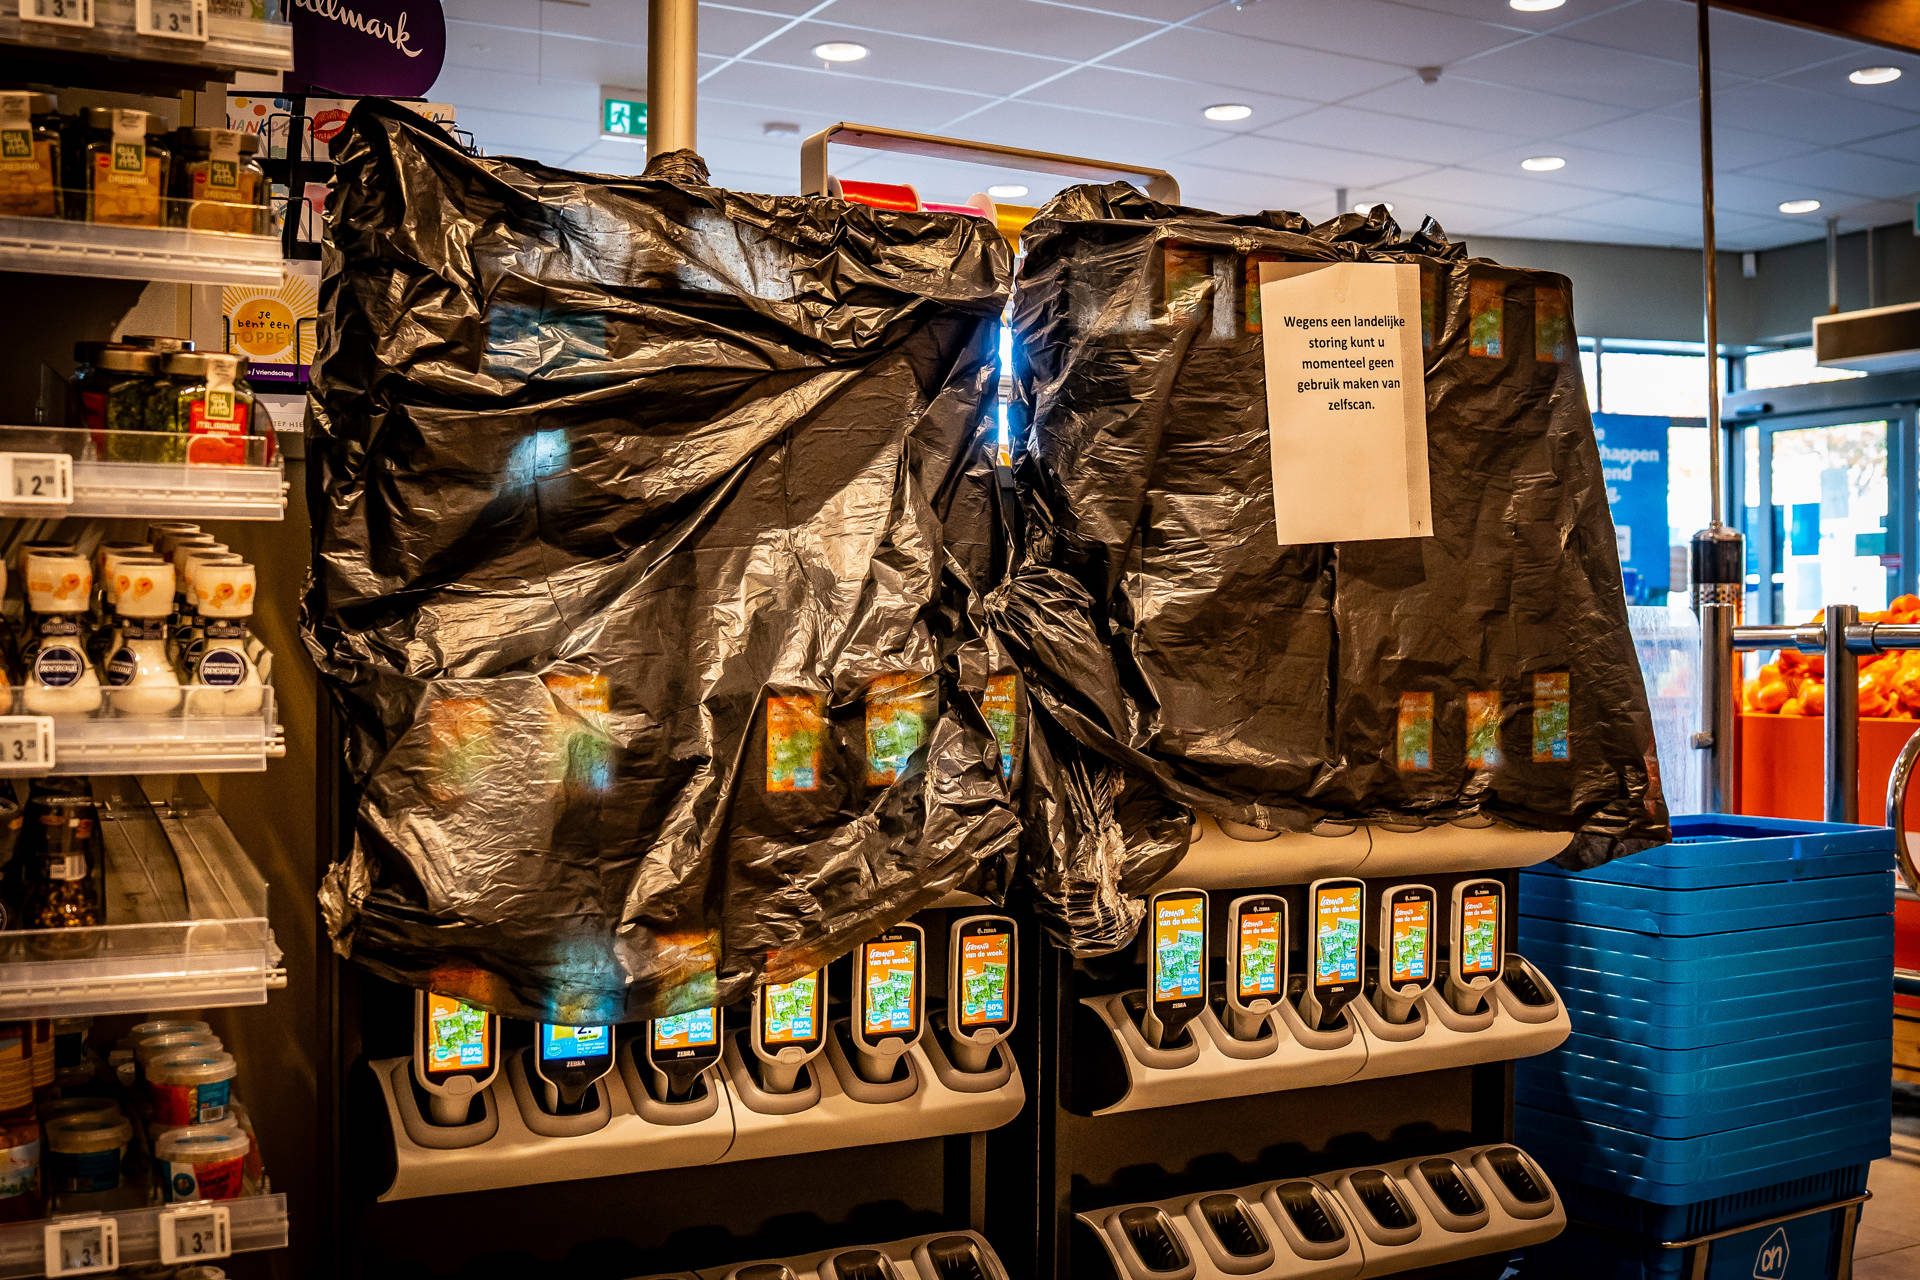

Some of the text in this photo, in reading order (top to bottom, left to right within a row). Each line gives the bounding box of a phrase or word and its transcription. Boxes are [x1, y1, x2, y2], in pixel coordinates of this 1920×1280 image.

[238, 320, 290, 329] bent een
[1284, 315, 1405, 329] Wegens een landelijke
[1308, 336, 1385, 350] storing kunt u
[1302, 357, 1394, 371] momenteel geen
[1297, 378, 1401, 393] gebruik maken van
[1328, 399, 1375, 411] zelfscan.
[1600, 444, 1660, 464] happen
[1183, 977, 1199, 986] 50%
[690, 1022, 711, 1031] 50%
[794, 1021, 810, 1029] 50%
[462, 1047, 482, 1056] 50%
[677, 1050, 695, 1058] ZEBRA
[566, 1060, 586, 1068] ZEBRA
